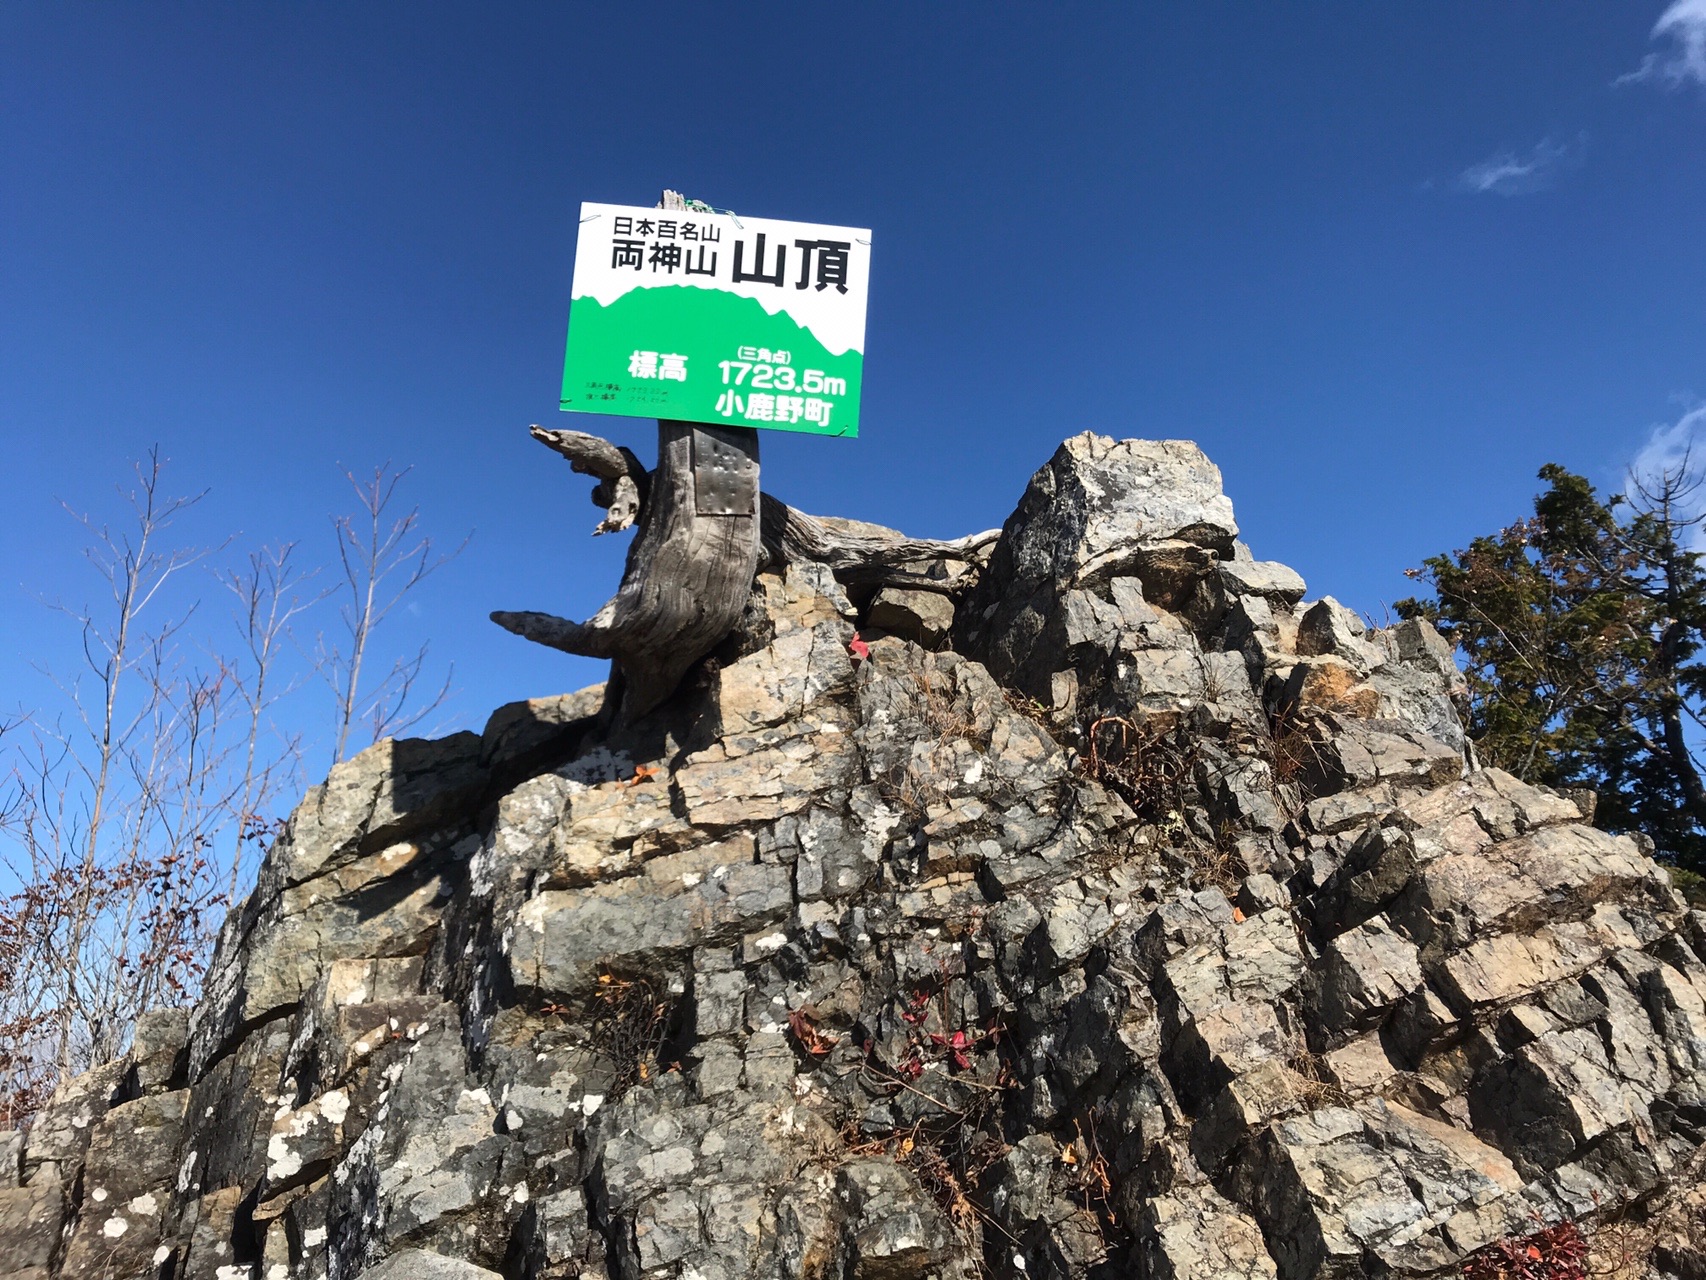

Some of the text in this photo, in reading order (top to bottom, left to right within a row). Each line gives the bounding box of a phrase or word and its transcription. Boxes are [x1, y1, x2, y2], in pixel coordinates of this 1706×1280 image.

[614, 217, 720, 242] 日本百名山
[612, 233, 850, 294] 両神山 山頂
[628, 350, 846, 396] 標高 1723.5m
[715, 389, 833, 427] 小鹿野町
